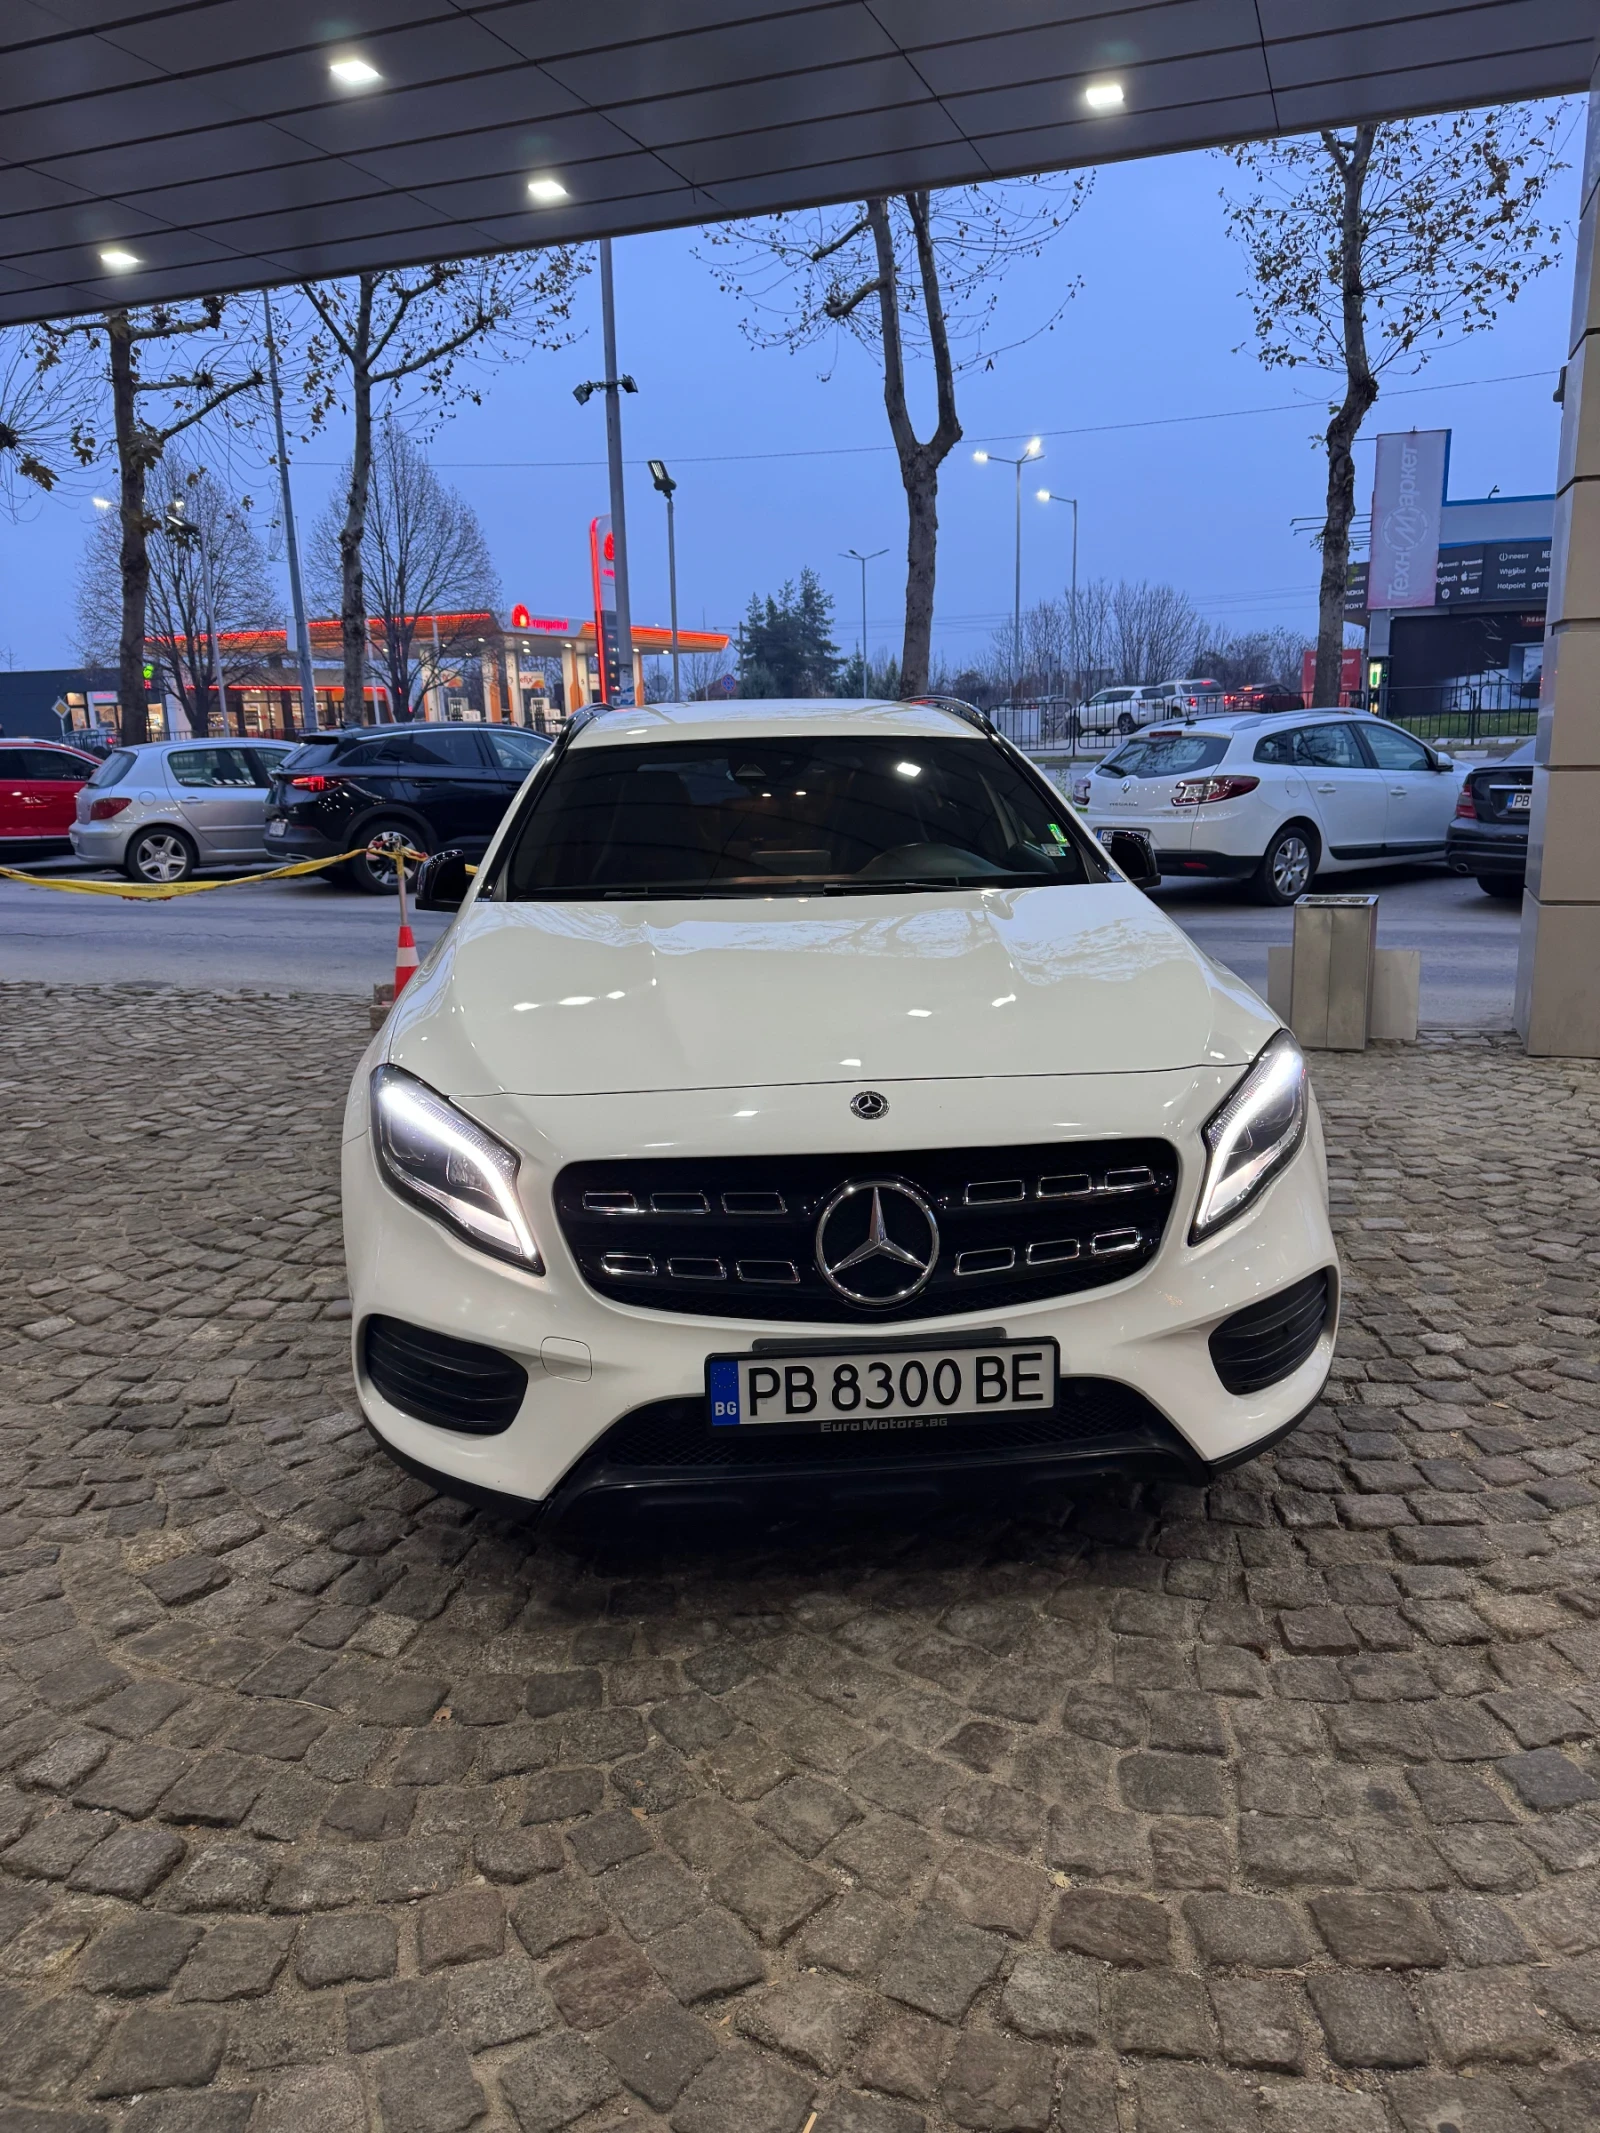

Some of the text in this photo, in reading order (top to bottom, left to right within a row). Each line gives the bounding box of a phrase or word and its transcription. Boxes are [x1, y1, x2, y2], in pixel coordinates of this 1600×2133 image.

[1499, 566, 1527, 578] Whirlpool
[1496, 582, 1527, 591] Hotpoint
[1345, 602, 1364, 610] SONY
[1514, 795, 1530, 807] PB
[748, 1352, 1044, 1417] PB 8300 BE
[714, 1401, 737, 1417] BG
